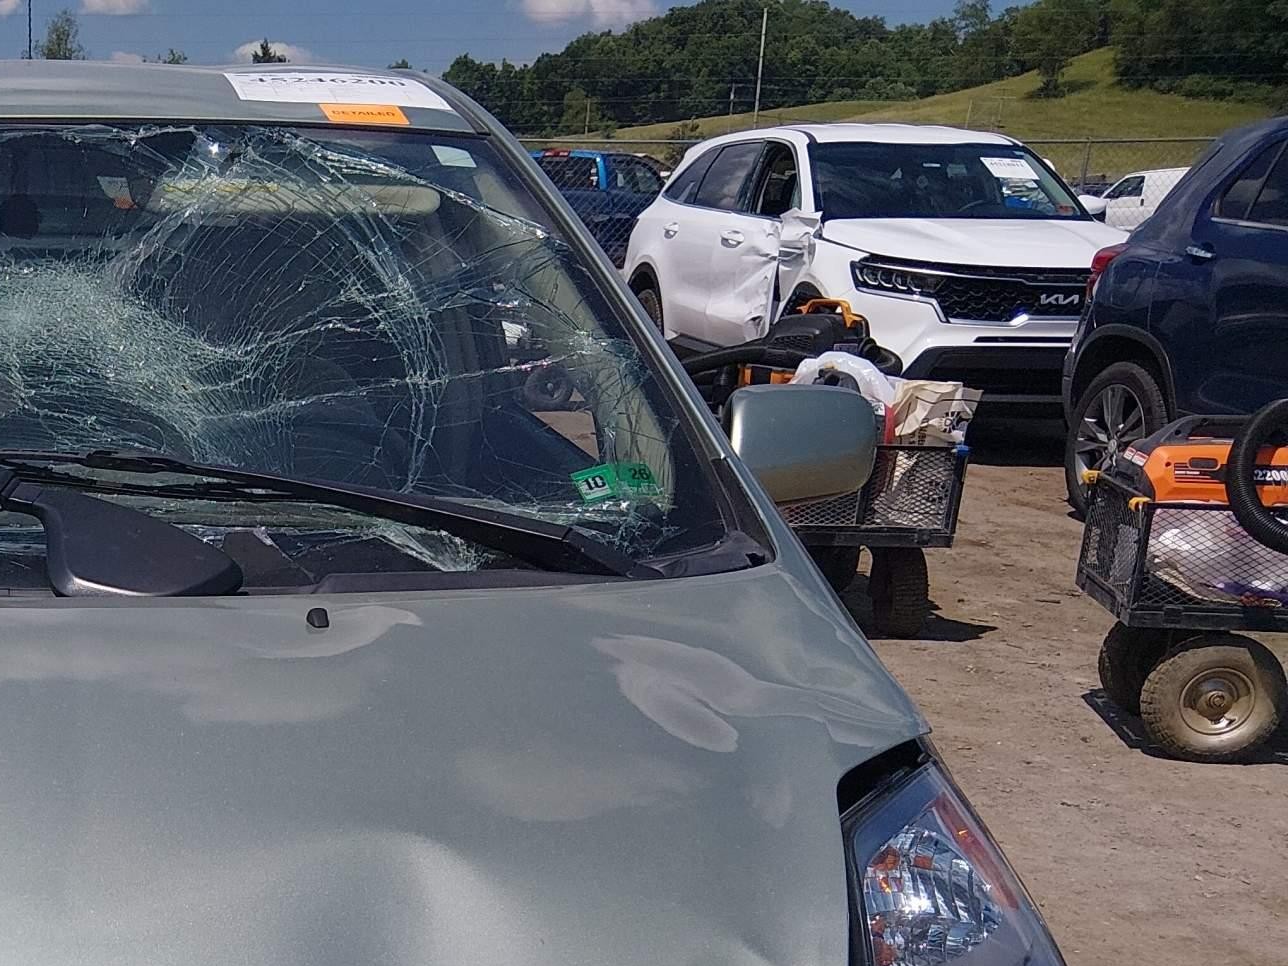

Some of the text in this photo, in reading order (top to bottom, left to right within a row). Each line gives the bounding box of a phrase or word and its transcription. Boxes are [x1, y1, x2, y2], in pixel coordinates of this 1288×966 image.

[250, 76, 406, 88] 45246200
[1040, 293, 1080, 305] KIA
[1253, 468, 1288, 482] 2200
[582, 474, 607, 491] 10
